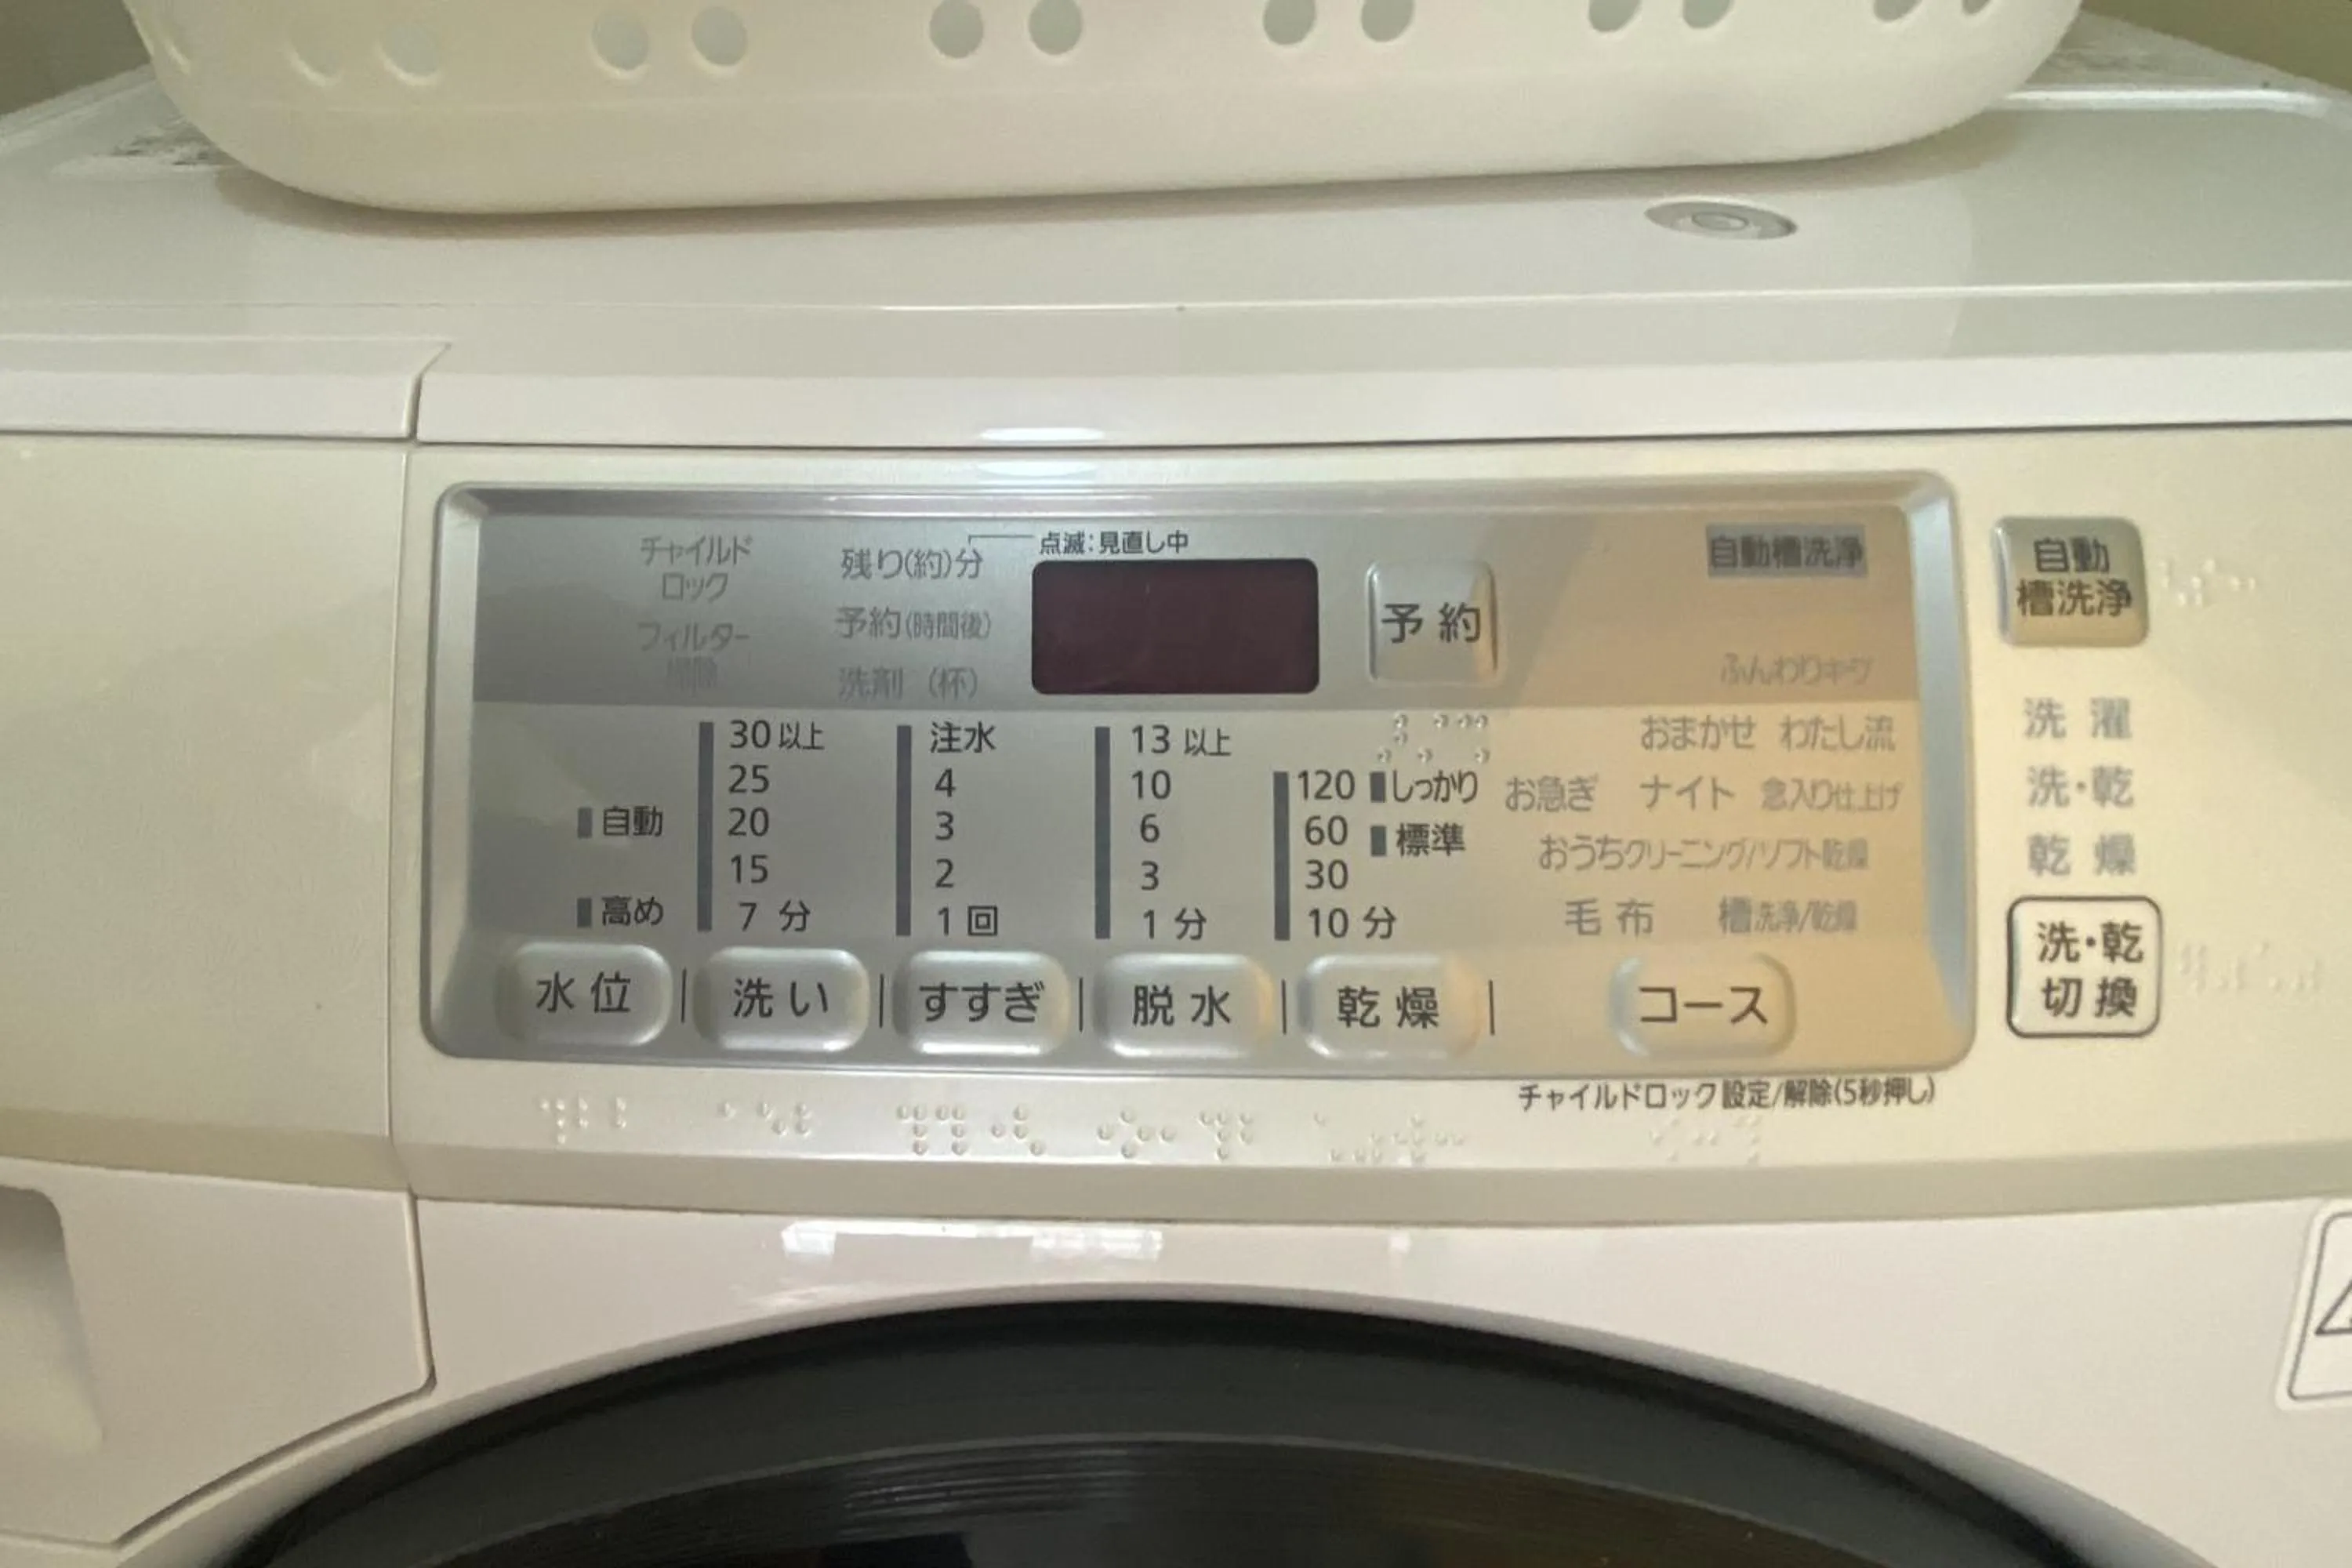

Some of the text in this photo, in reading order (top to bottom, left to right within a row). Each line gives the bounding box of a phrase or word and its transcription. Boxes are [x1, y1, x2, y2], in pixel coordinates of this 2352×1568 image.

[641, 535, 753, 566] チャイルド
[2033, 536, 2111, 573] 自動
[661, 572, 729, 603] ロック
[2016, 579, 2134, 617] 槽洗浄
[638, 621, 750, 652] フィルター
[1381, 602, 1481, 644] 予約
[1640, 714, 1896, 752] おまかせ わたし流
[2024, 697, 2132, 740] 洗濯
[930, 720, 996, 753] 注水
[728, 764, 770, 794] 25
[935, 768, 956, 798] 4
[1131, 769, 1171, 800] 10
[1298, 769, 1356, 800] 120
[1392, 769, 1479, 804] しっかり
[1504, 775, 1598, 813] お急ぎ
[1639, 774, 1735, 811] ナイト
[603, 805, 663, 837] 自動
[728, 806, 770, 837] 20
[935, 810, 954, 841] 3
[1139, 813, 1160, 844] 6
[1305, 815, 1348, 846] 60
[1396, 822, 1466, 857] 標準
[2027, 833, 2136, 877] 乾燥
[731, 854, 768, 884] 15
[935, 858, 954, 889] 2
[1141, 860, 1160, 891] 3
[1305, 858, 1349, 891] 30
[601, 895, 664, 927] 高め
[1564, 898, 1654, 937] 毛布
[536, 971, 631, 1014] 水位
[733, 977, 829, 1018] 洗い
[919, 980, 1045, 1023] すすぎ
[1132, 984, 1231, 1027] 脱水
[1338, 985, 1439, 1029] 乾燥
[1639, 985, 1768, 1025] コース
[2041, 976, 2138, 1018] 切換
